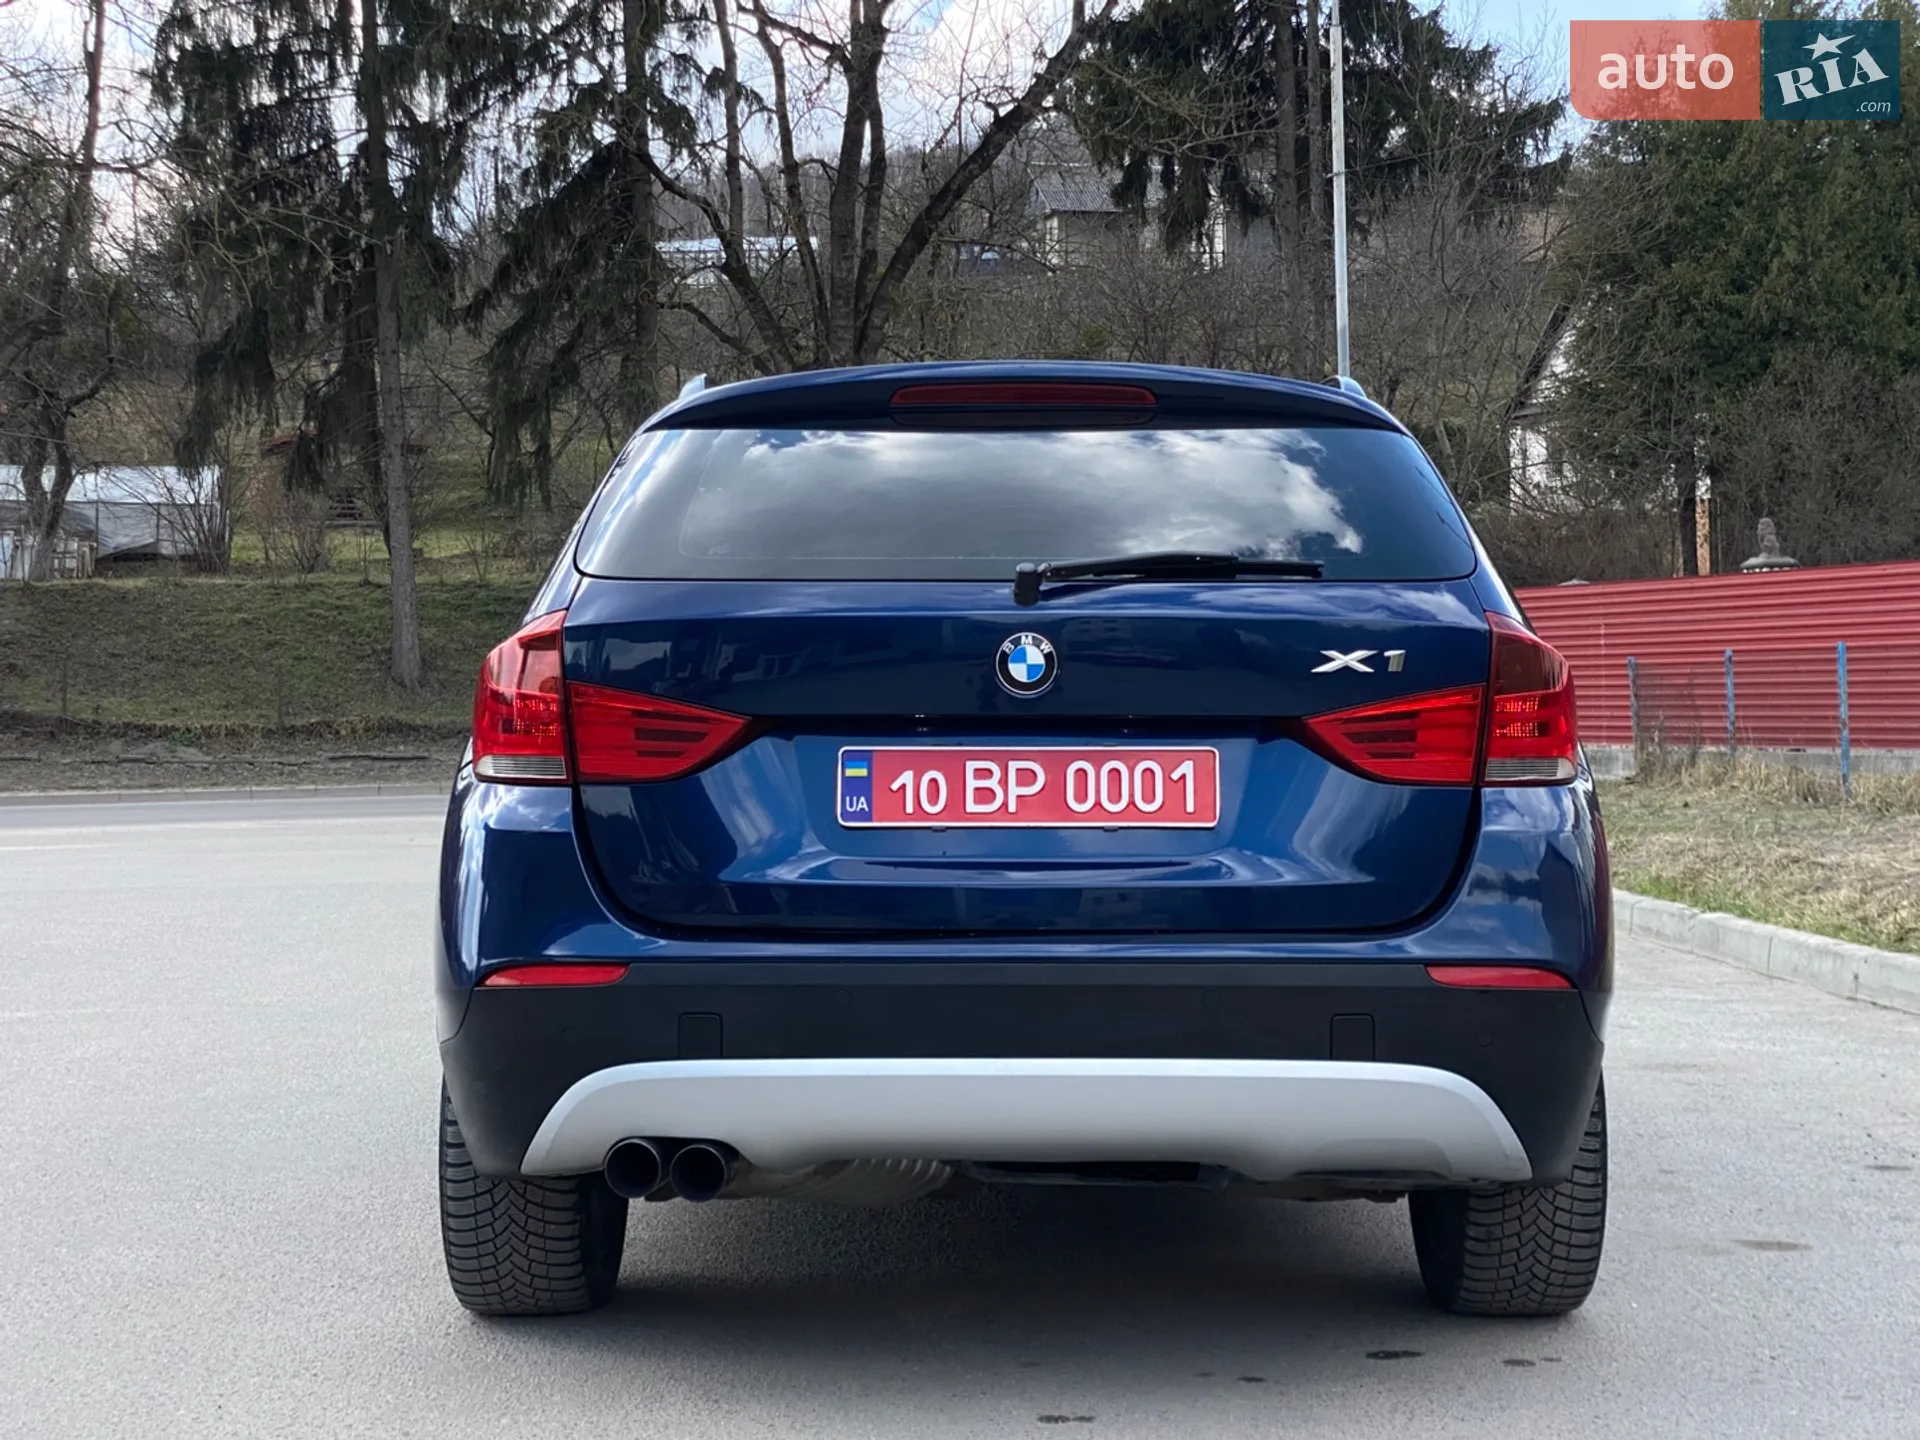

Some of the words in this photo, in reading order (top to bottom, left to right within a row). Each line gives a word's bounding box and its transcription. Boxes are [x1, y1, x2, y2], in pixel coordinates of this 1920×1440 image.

[1002, 634, 1053, 655] BMW
[1310, 649, 1407, 673] X1
[889, 770, 947, 815] 10
[964, 759, 1046, 814] BP
[1065, 759, 1196, 814] 0001
[845, 796, 869, 812] UA
